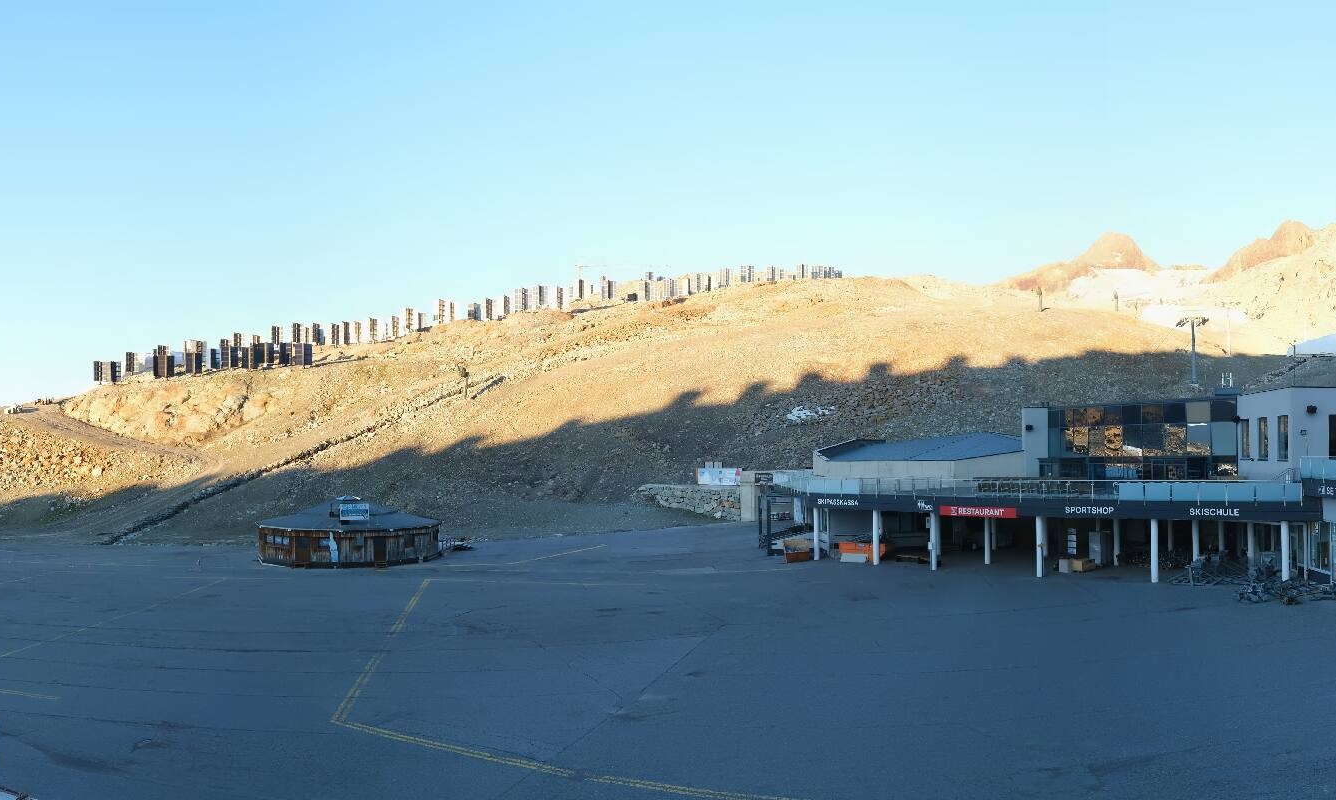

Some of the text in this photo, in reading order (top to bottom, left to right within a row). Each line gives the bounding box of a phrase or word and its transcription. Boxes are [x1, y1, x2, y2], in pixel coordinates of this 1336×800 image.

[817, 498, 859, 506] SKIPASSKASSA
[958, 507, 1005, 516] RESTAURANT
[1065, 506, 1114, 514] SPORTSHOP
[1189, 507, 1239, 516] SKISCHULE
